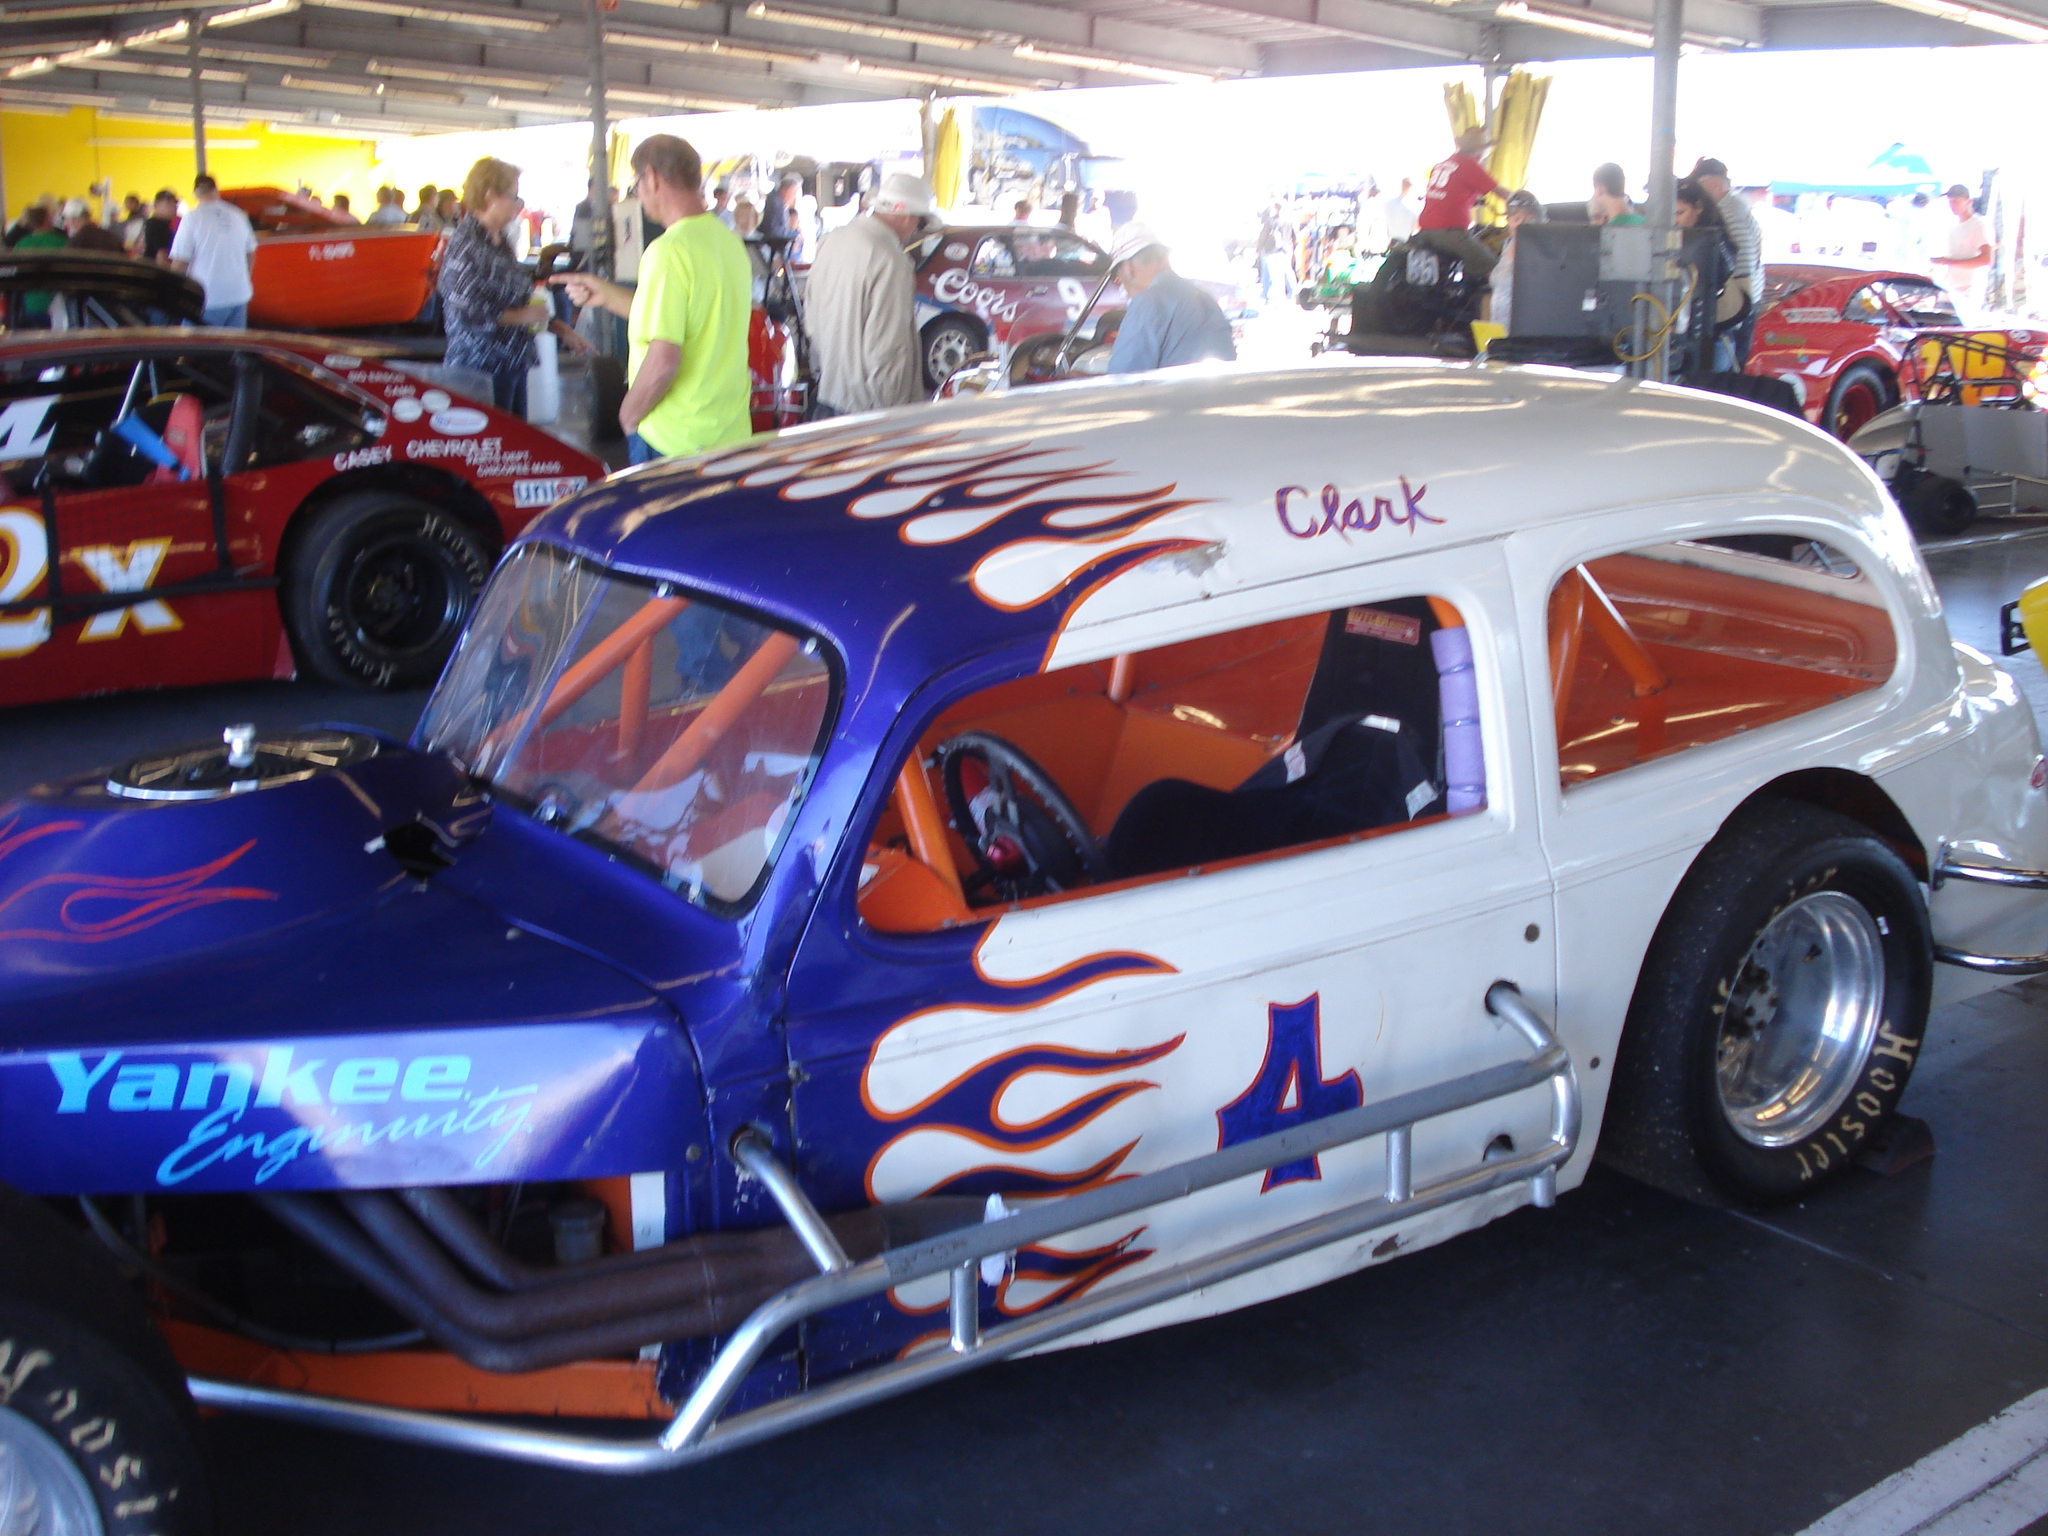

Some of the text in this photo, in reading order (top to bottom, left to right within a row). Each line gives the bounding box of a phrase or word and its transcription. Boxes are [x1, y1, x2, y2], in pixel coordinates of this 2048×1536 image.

[929, 267, 1020, 322] Coors
[1056, 276, 1089, 322] 9
[1275, 474, 1448, 546] Clark
[47, 1045, 472, 1114] Yankee
[1216, 990, 1364, 1196] 4
[156, 1083, 538, 1187] Enginuity
